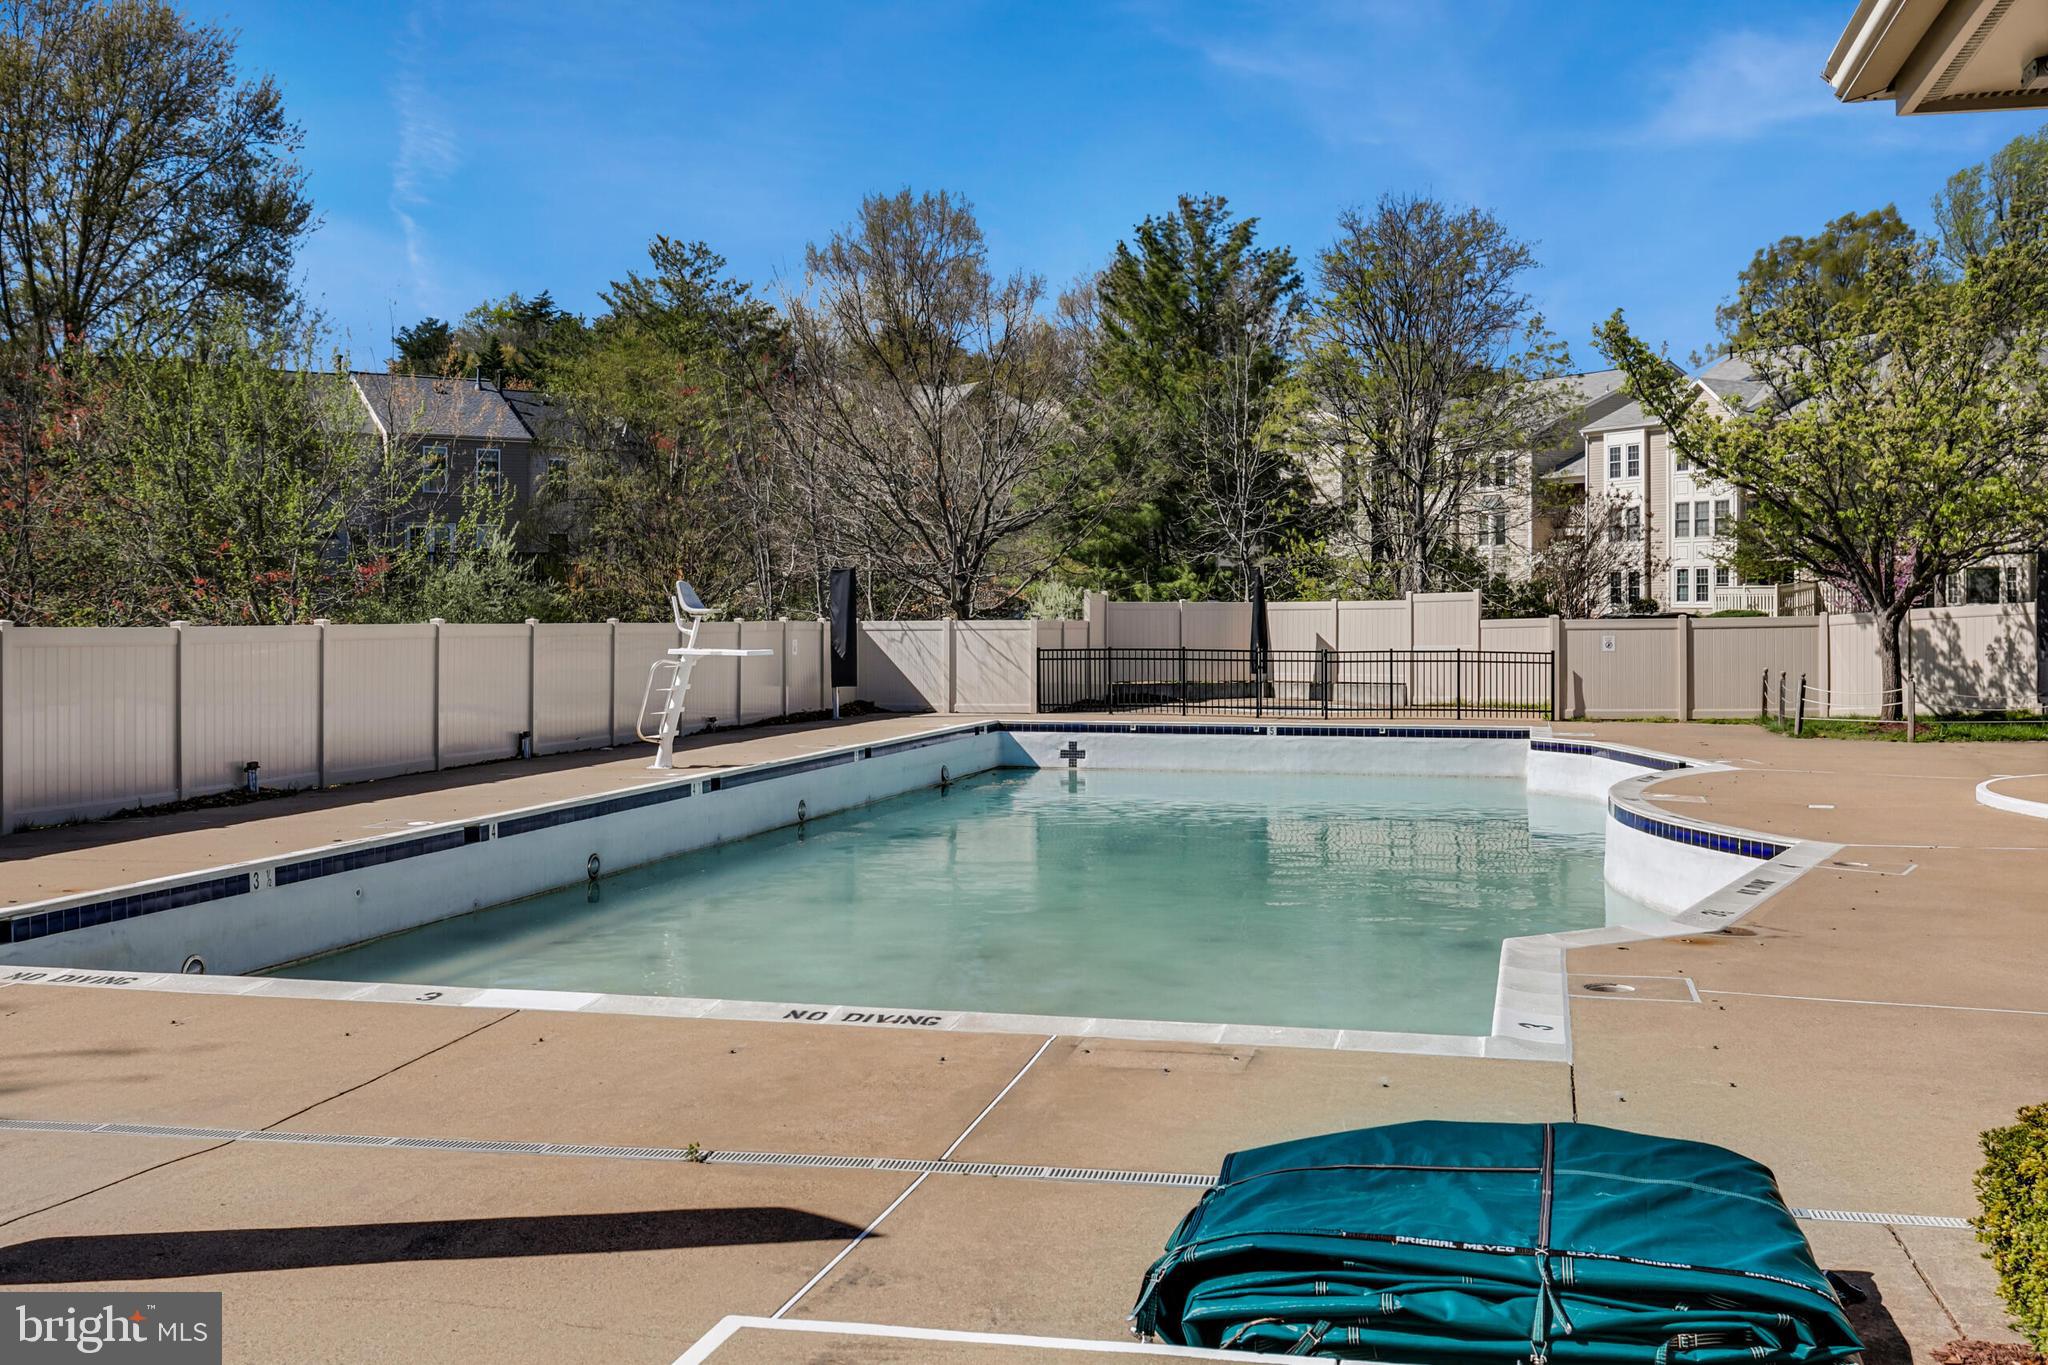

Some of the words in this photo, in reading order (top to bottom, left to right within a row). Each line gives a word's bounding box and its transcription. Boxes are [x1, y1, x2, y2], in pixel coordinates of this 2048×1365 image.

[253, 871, 260, 890] 3
[2, 972, 48, 981] NO
[47, 974, 139, 985] DIVING
[783, 1009, 829, 1021] NO
[841, 1012, 942, 1026] DIVING
[1396, 1235, 1457, 1249] ORIGINAL
[1463, 1242, 1516, 1253] MEYCO
